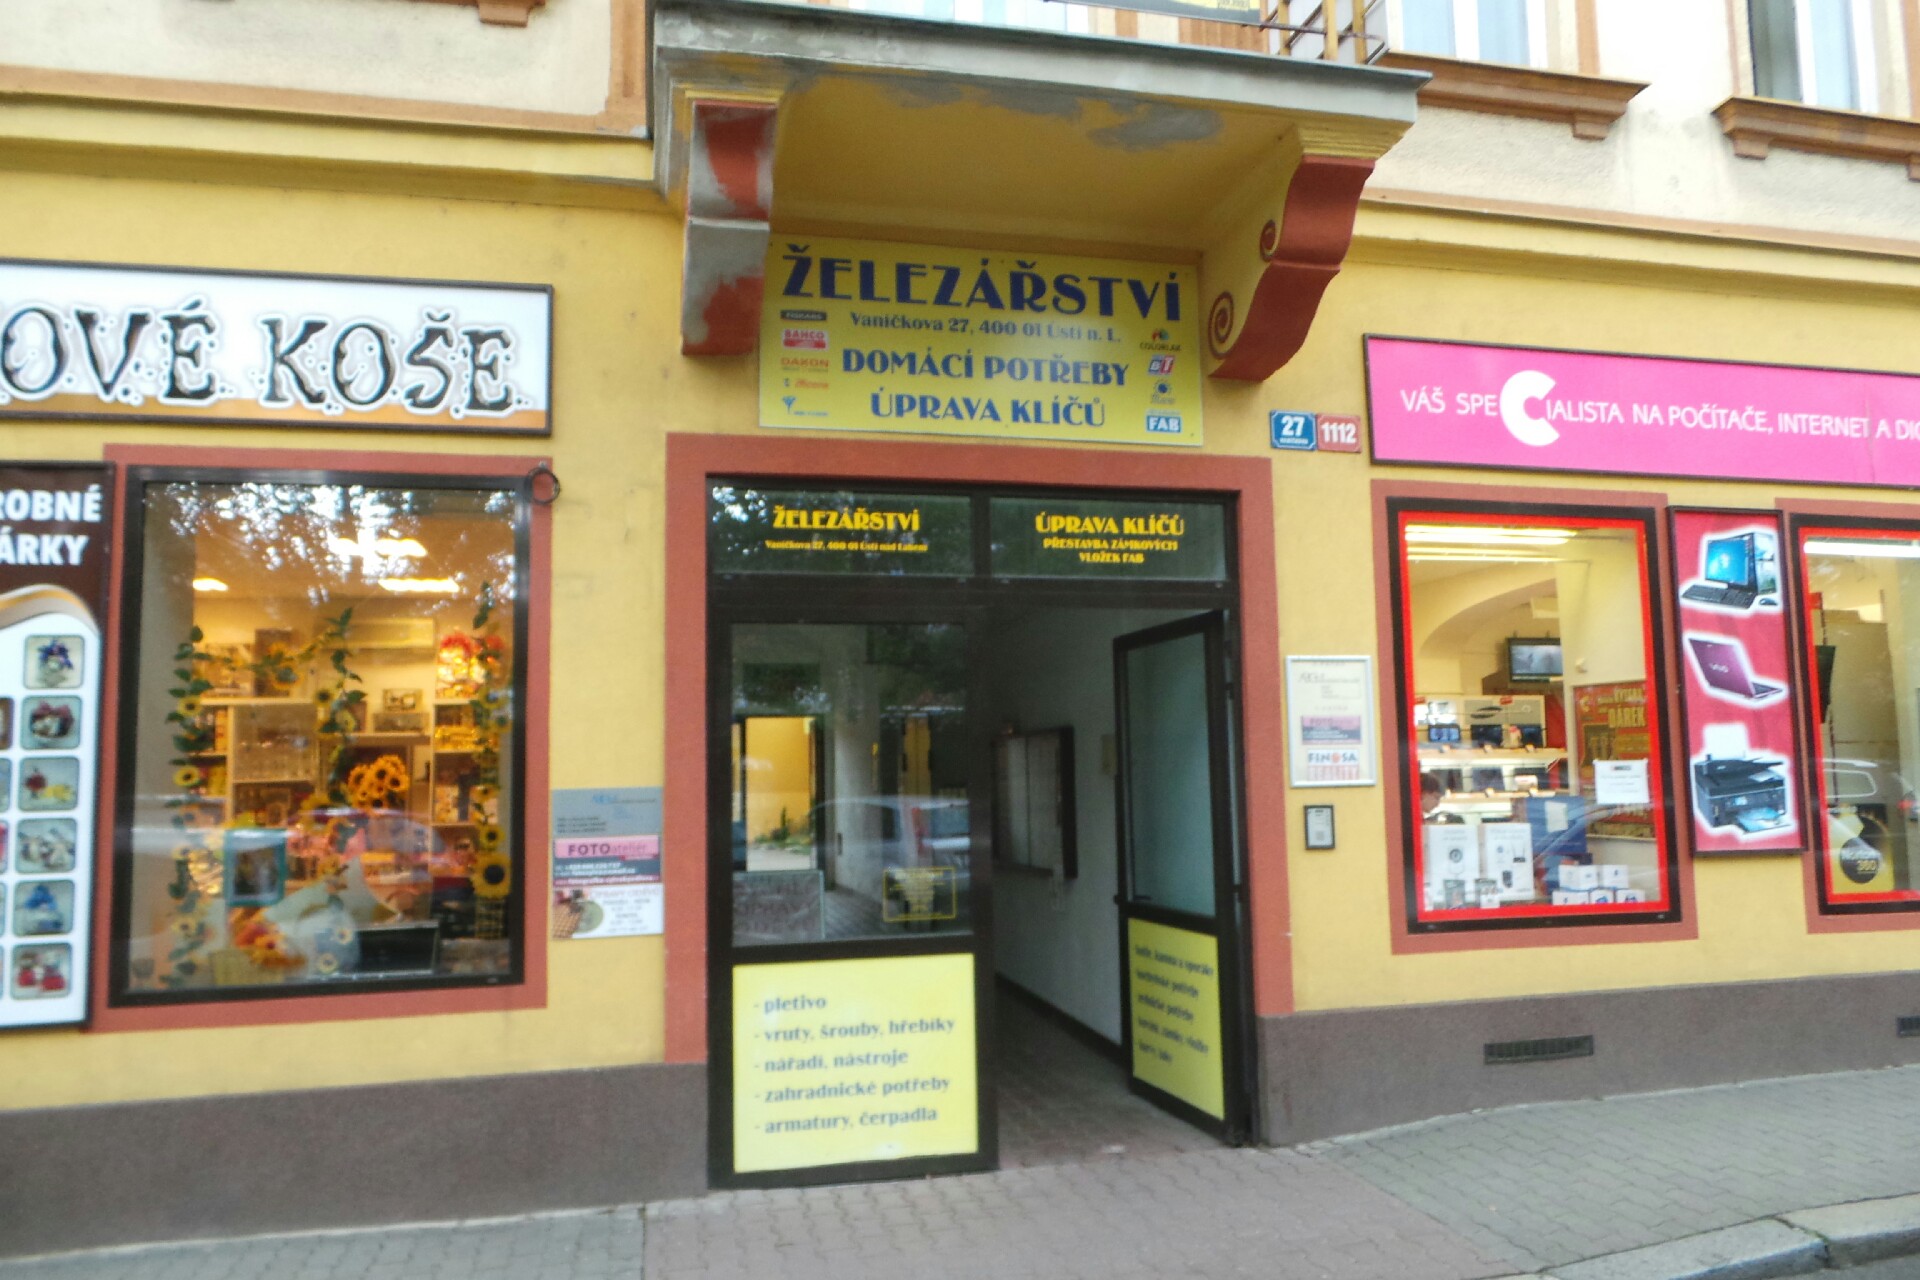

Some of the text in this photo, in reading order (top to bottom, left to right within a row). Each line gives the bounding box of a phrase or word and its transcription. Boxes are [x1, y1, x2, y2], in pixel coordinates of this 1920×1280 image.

[783, 244, 1180, 322] ŽELEZÁŘSTVÍ
[784, 328, 825, 339] BAHCO
[948, 318, 974, 336] 27,
[979, 320, 1017, 336] 400
[258, 312, 514, 410] KOŠE
[842, 346, 1129, 387] DOMÁCÍ POTŘEBY
[870, 387, 1105, 427] ÚPRAVA KLÍČŮ
[1400, 385, 1446, 415] VÁŠ
[1455, 370, 1625, 447] SPECIALISTA
[1632, 402, 1664, 427] NA
[1668, 403, 1774, 435] POČÍTAČE,
[1777, 412, 1870, 438] INTERNET
[1875, 418, 1892, 440] A
[1148, 416, 1181, 431] FAB
[1281, 415, 1306, 437] 27
[1321, 422, 1357, 444] 1112
[0, 483, 104, 523] OBNÉ
[773, 504, 921, 532] ŽELEZÁŘSTVÍ
[1035, 511, 1185, 536] ÚPRAVA KLÍČŮ
[764, 994, 827, 1014] pletivo
[764, 1027, 815, 1044] vruty,
[820, 1021, 884, 1040] šrouby,
[764, 1076, 951, 1103] zahradnické potřeby
[764, 1107, 939, 1134] armatury, čerpadla
